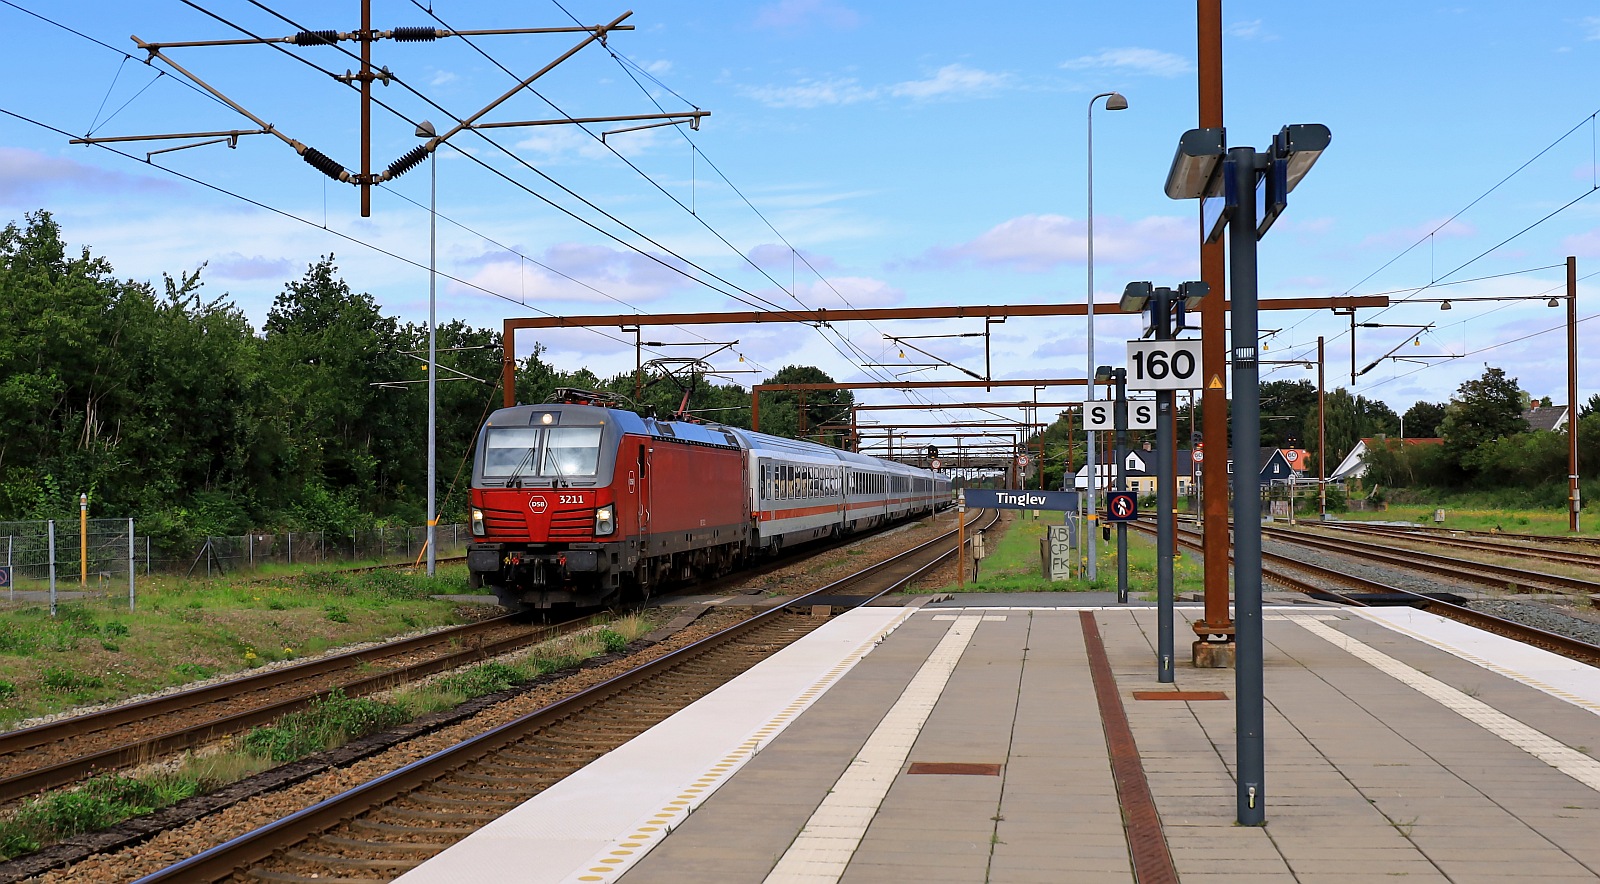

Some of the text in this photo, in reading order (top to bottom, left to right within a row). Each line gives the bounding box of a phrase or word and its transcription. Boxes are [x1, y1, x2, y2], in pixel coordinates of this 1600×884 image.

[1132, 349, 1196, 380] 160
[1091, 406, 1107, 425] S
[1136, 405, 1151, 424] S
[559, 495, 584, 504] 3211
[996, 492, 1046, 507] Tinglev
